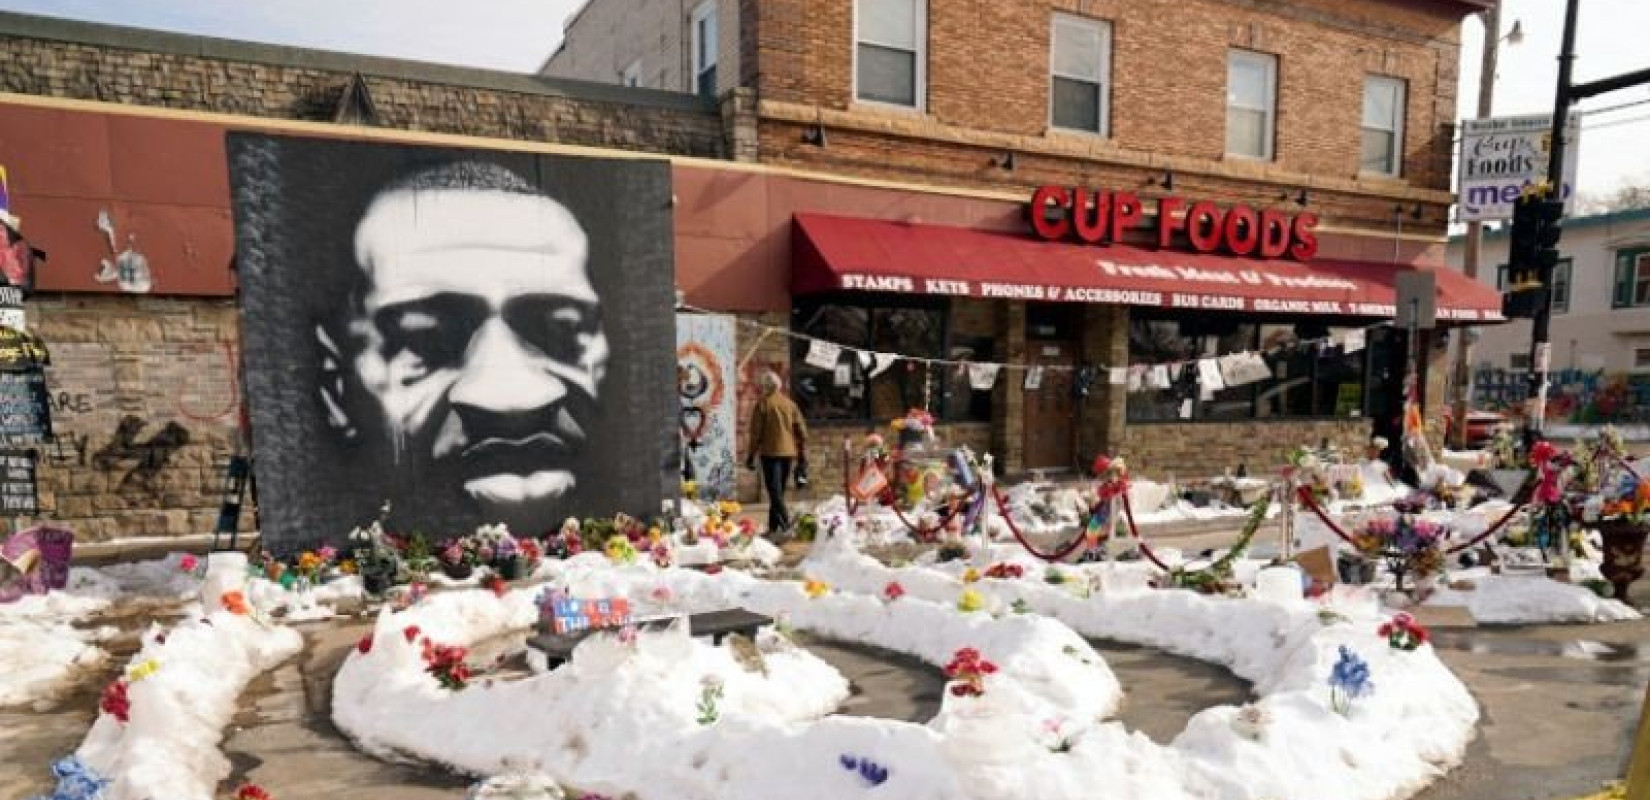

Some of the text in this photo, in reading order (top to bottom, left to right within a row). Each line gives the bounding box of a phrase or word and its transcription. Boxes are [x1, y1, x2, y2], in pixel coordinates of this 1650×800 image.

[1467, 154, 1533, 176] Foods
[1031, 185, 1319, 262] CUP FOODS
[842, 274, 914, 292] STAMPS
[925, 279, 970, 295] KEYS
[981, 283, 1043, 299] PHONES
[1064, 288, 1161, 307] ACCESSORIES
[1172, 293, 1199, 307] BUS
[1202, 296, 1244, 309] CARDS
[1253, 299, 1310, 312] ORGANIC
